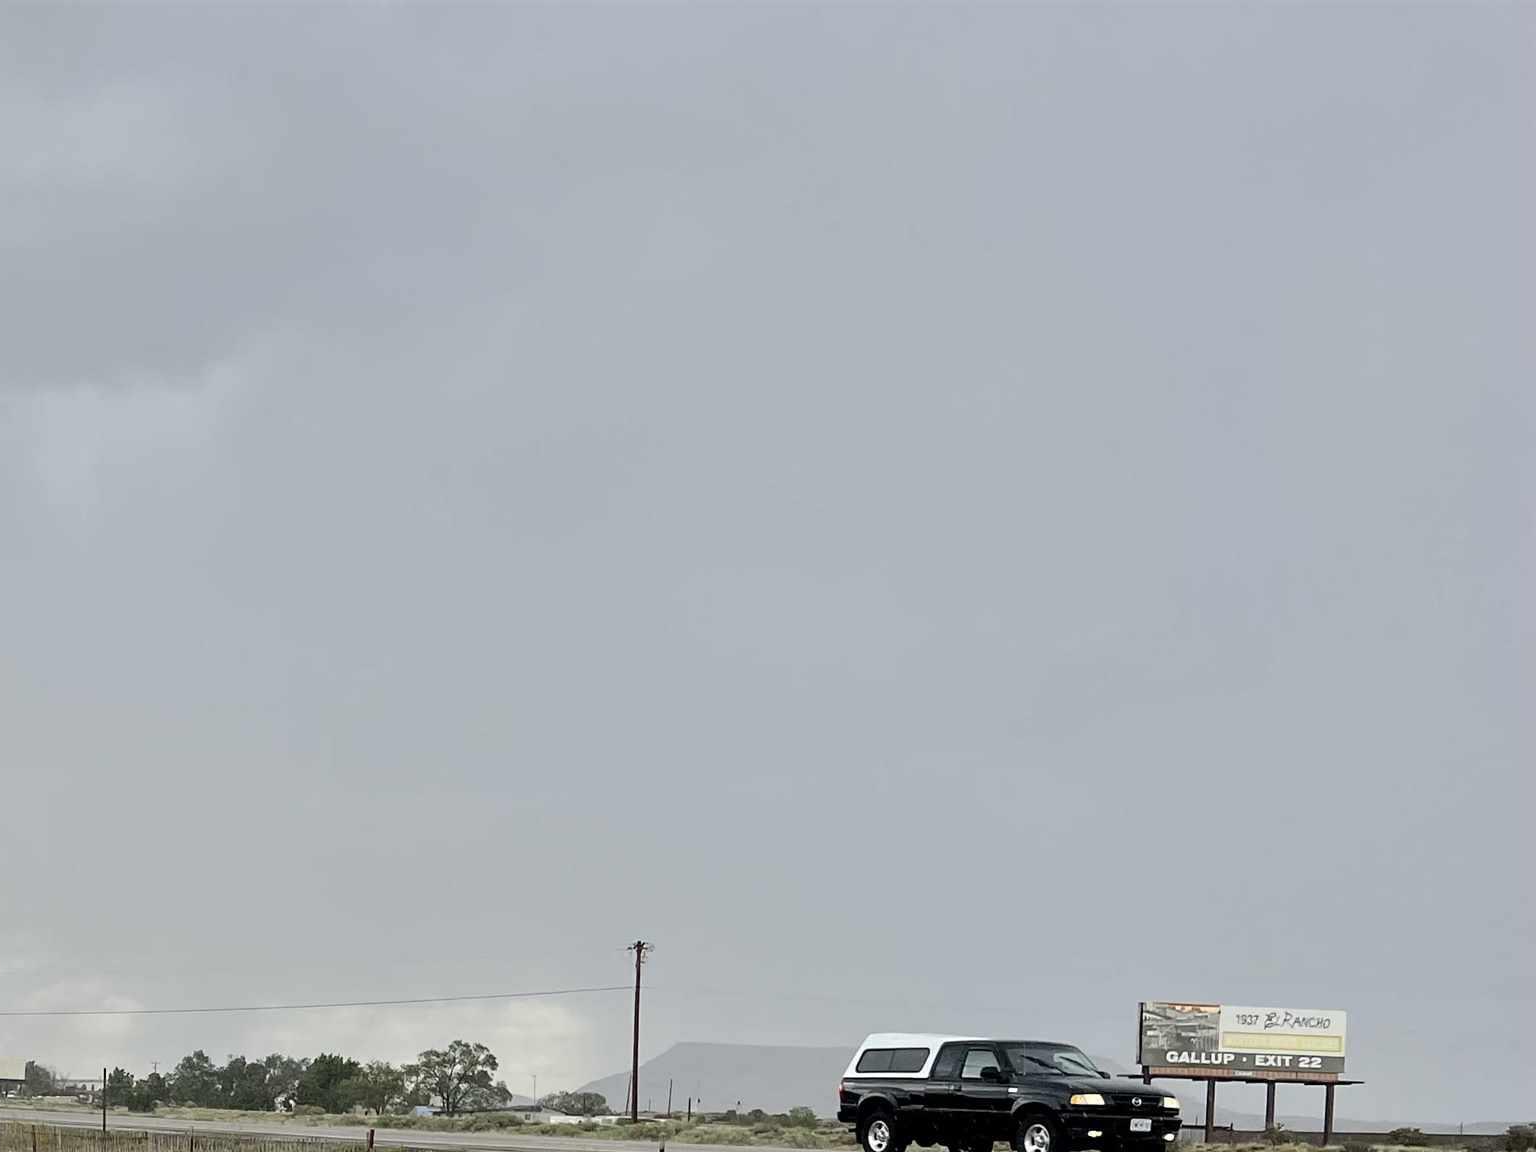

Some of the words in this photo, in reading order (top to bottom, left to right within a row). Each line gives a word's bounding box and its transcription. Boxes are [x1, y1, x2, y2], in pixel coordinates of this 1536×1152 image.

[1236, 1014, 1259, 1025] 1937
[1281, 1012, 1331, 1029] RANCHO
[1166, 1051, 1234, 1064] GALLUP
[1255, 1054, 1293, 1067] EXIT
[1298, 1057, 1322, 1068] 22
